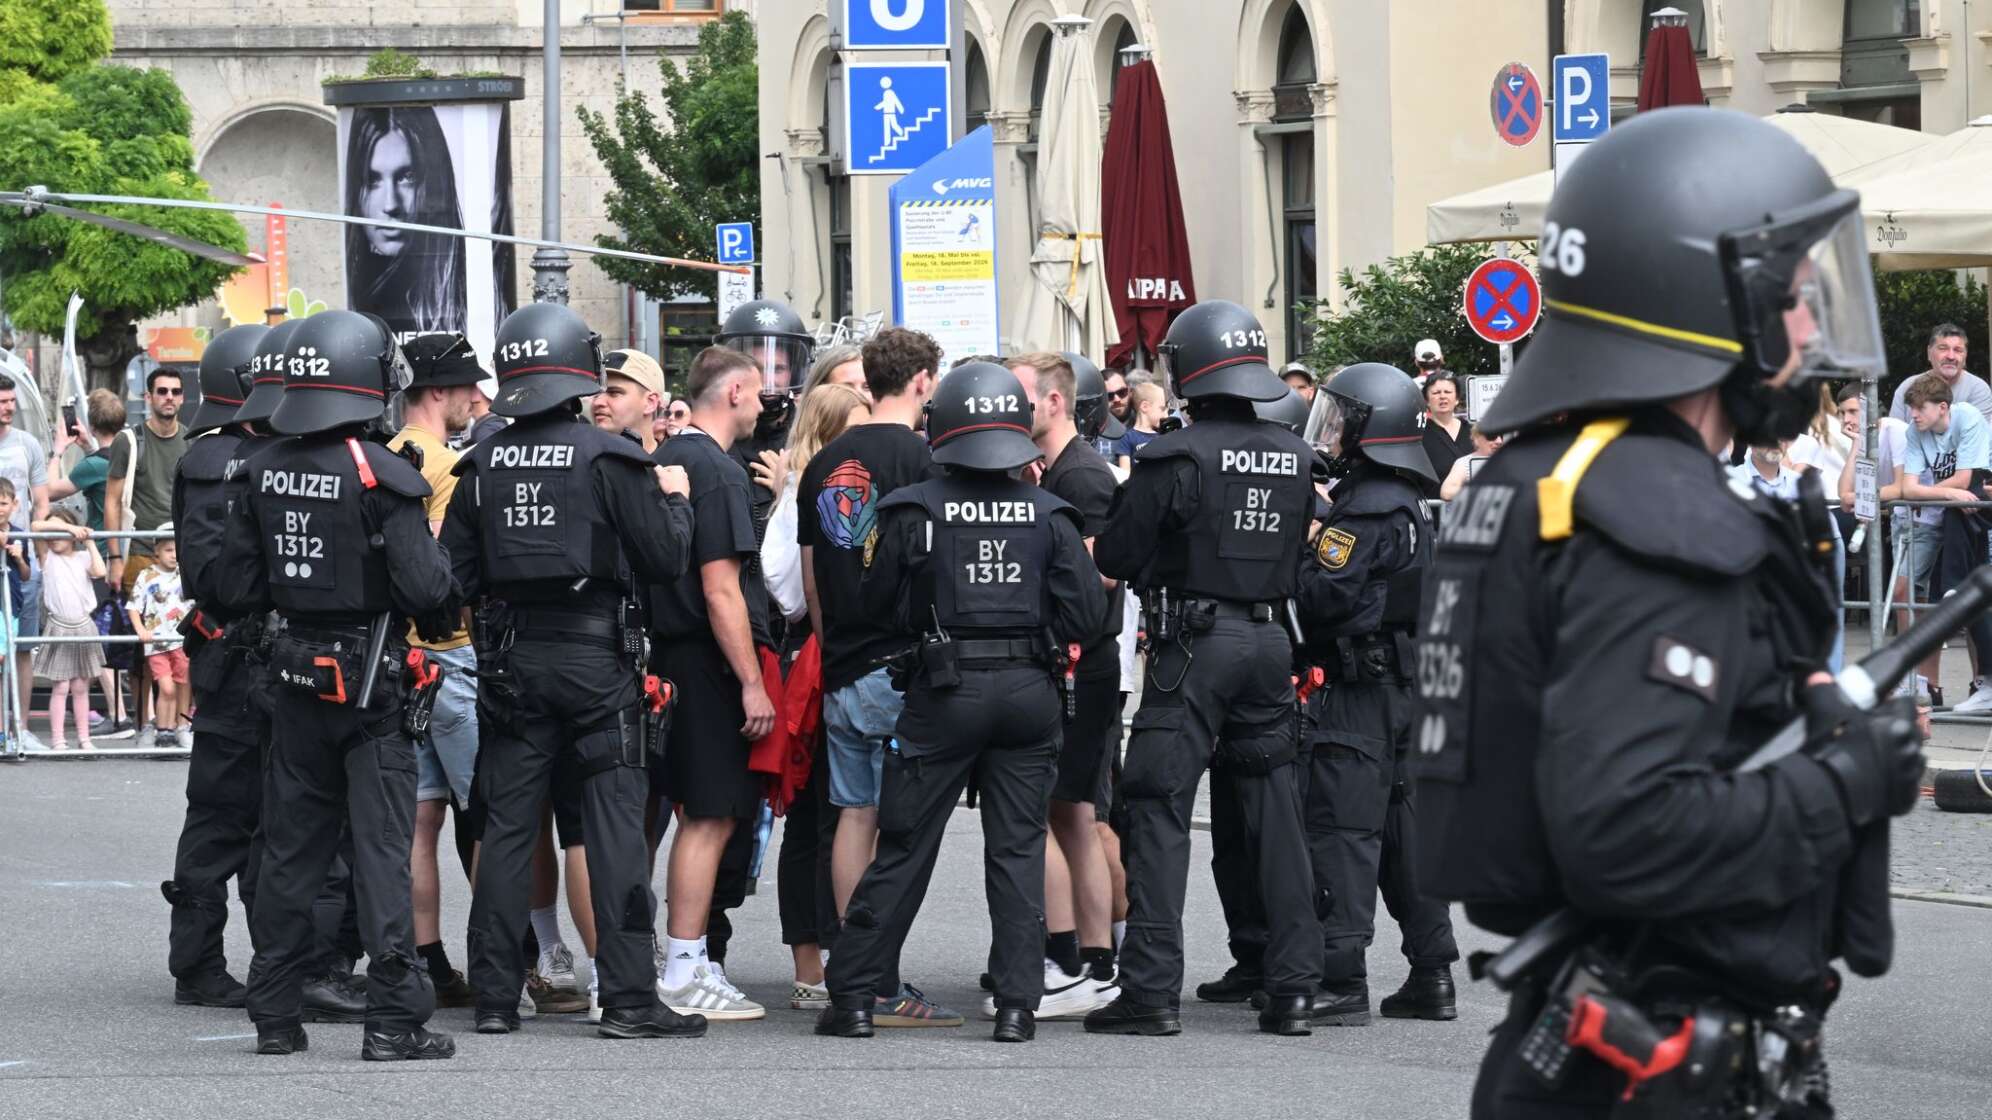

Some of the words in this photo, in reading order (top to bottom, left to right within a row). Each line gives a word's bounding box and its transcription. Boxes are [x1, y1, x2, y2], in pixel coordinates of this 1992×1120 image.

[1563, 66, 1593, 130] P
[950, 177, 992, 188] MVG
[723, 229, 742, 258] P
[501, 338, 549, 361] 1312
[1220, 330, 1266, 348] 1312
[288, 357, 330, 376] 1312
[965, 395, 1019, 413] 1312
[490, 445, 574, 467] POLIZEI
[1222, 449, 1297, 475] POLIZEI
[261, 470, 341, 499] POLIZEI
[516, 482, 541, 503] BY
[1246, 488, 1271, 509] BY
[285, 511, 311, 533] BY
[503, 505, 556, 527] 1312
[944, 502, 1035, 522] POLIZEI
[1233, 510, 1280, 533] 1312
[274, 534, 324, 558] 1312
[979, 540, 1007, 561] BY
[965, 562, 1021, 583] 1312
[292, 673, 315, 688] IFAK
